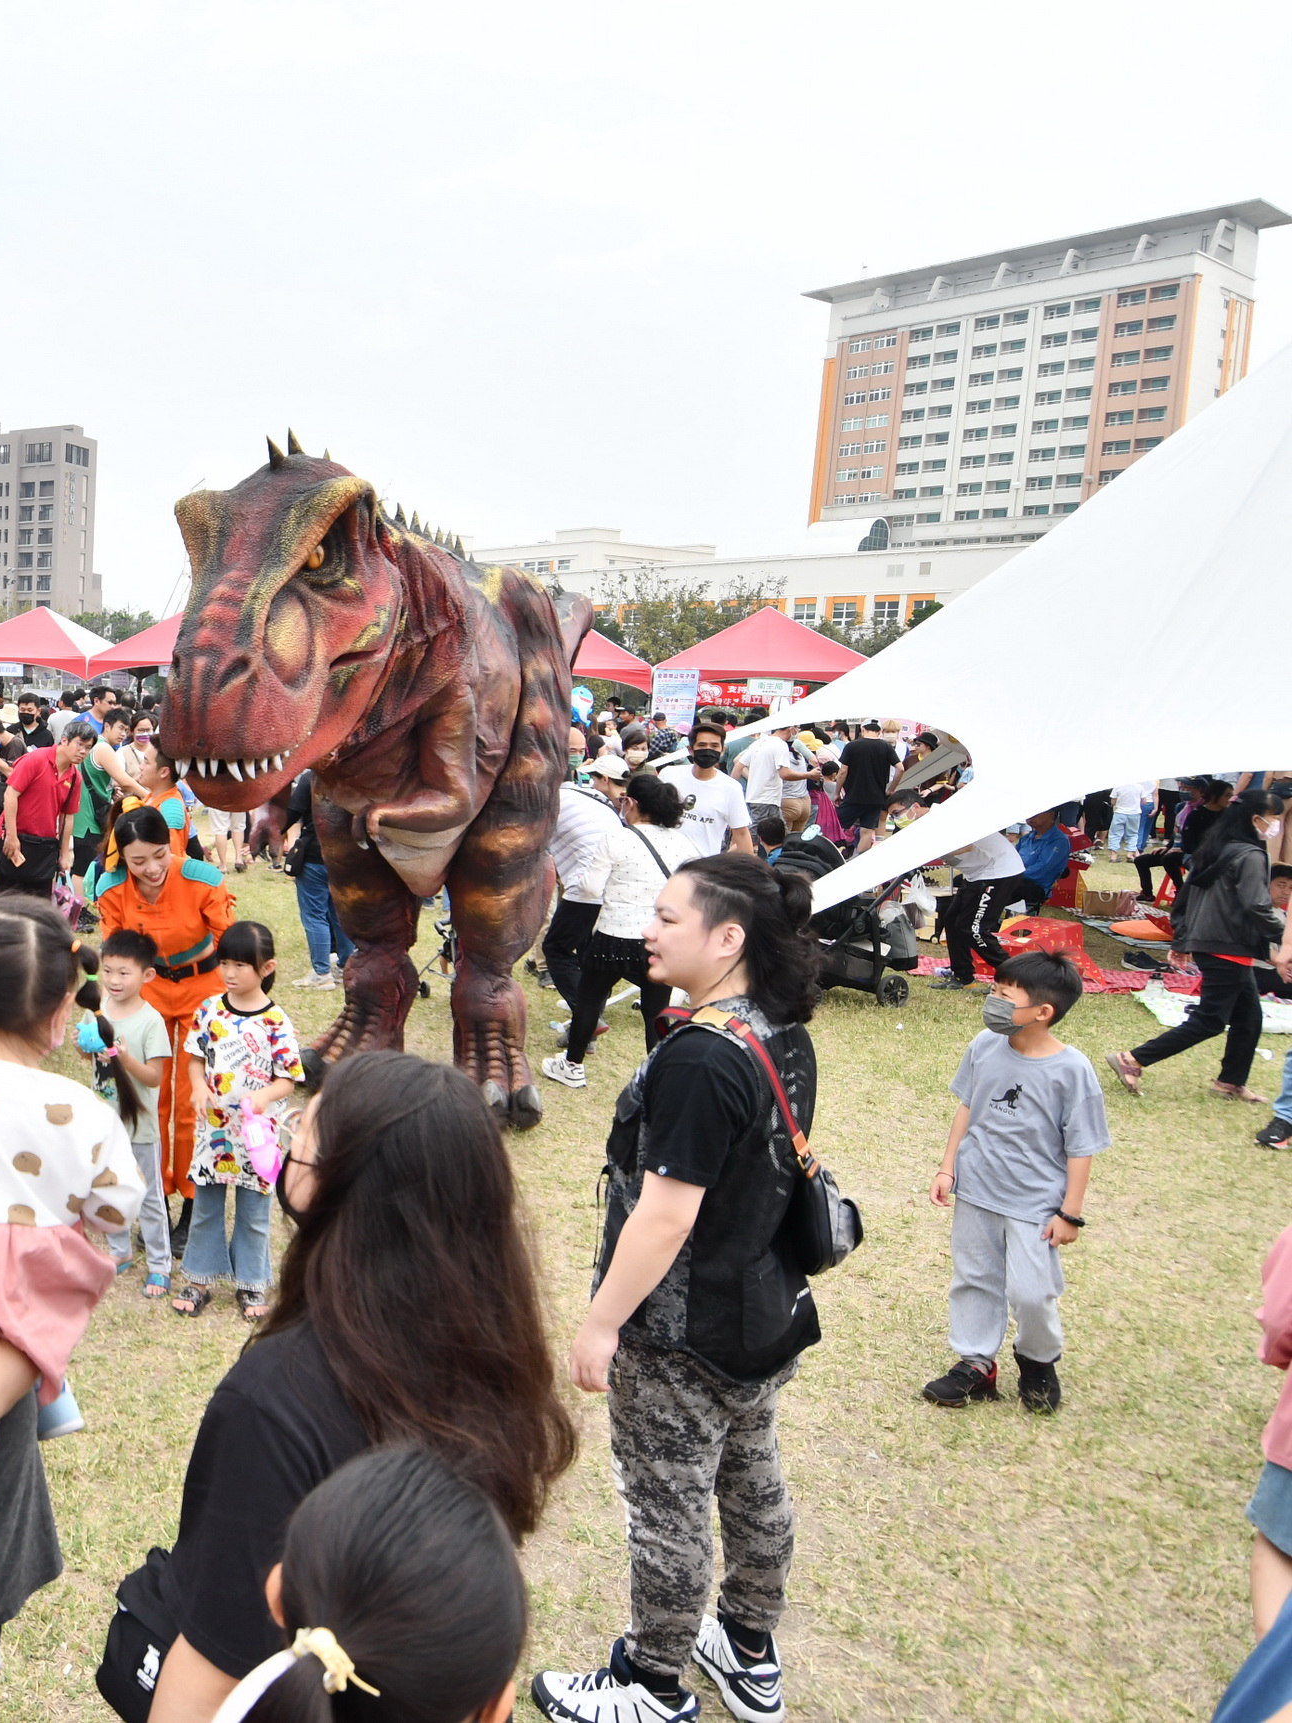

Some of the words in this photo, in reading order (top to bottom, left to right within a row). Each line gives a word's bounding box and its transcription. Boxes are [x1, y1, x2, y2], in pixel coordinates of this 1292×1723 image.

[758, 681, 783, 690] 衛生局
[989, 1102, 1016, 1117] KANGOL
